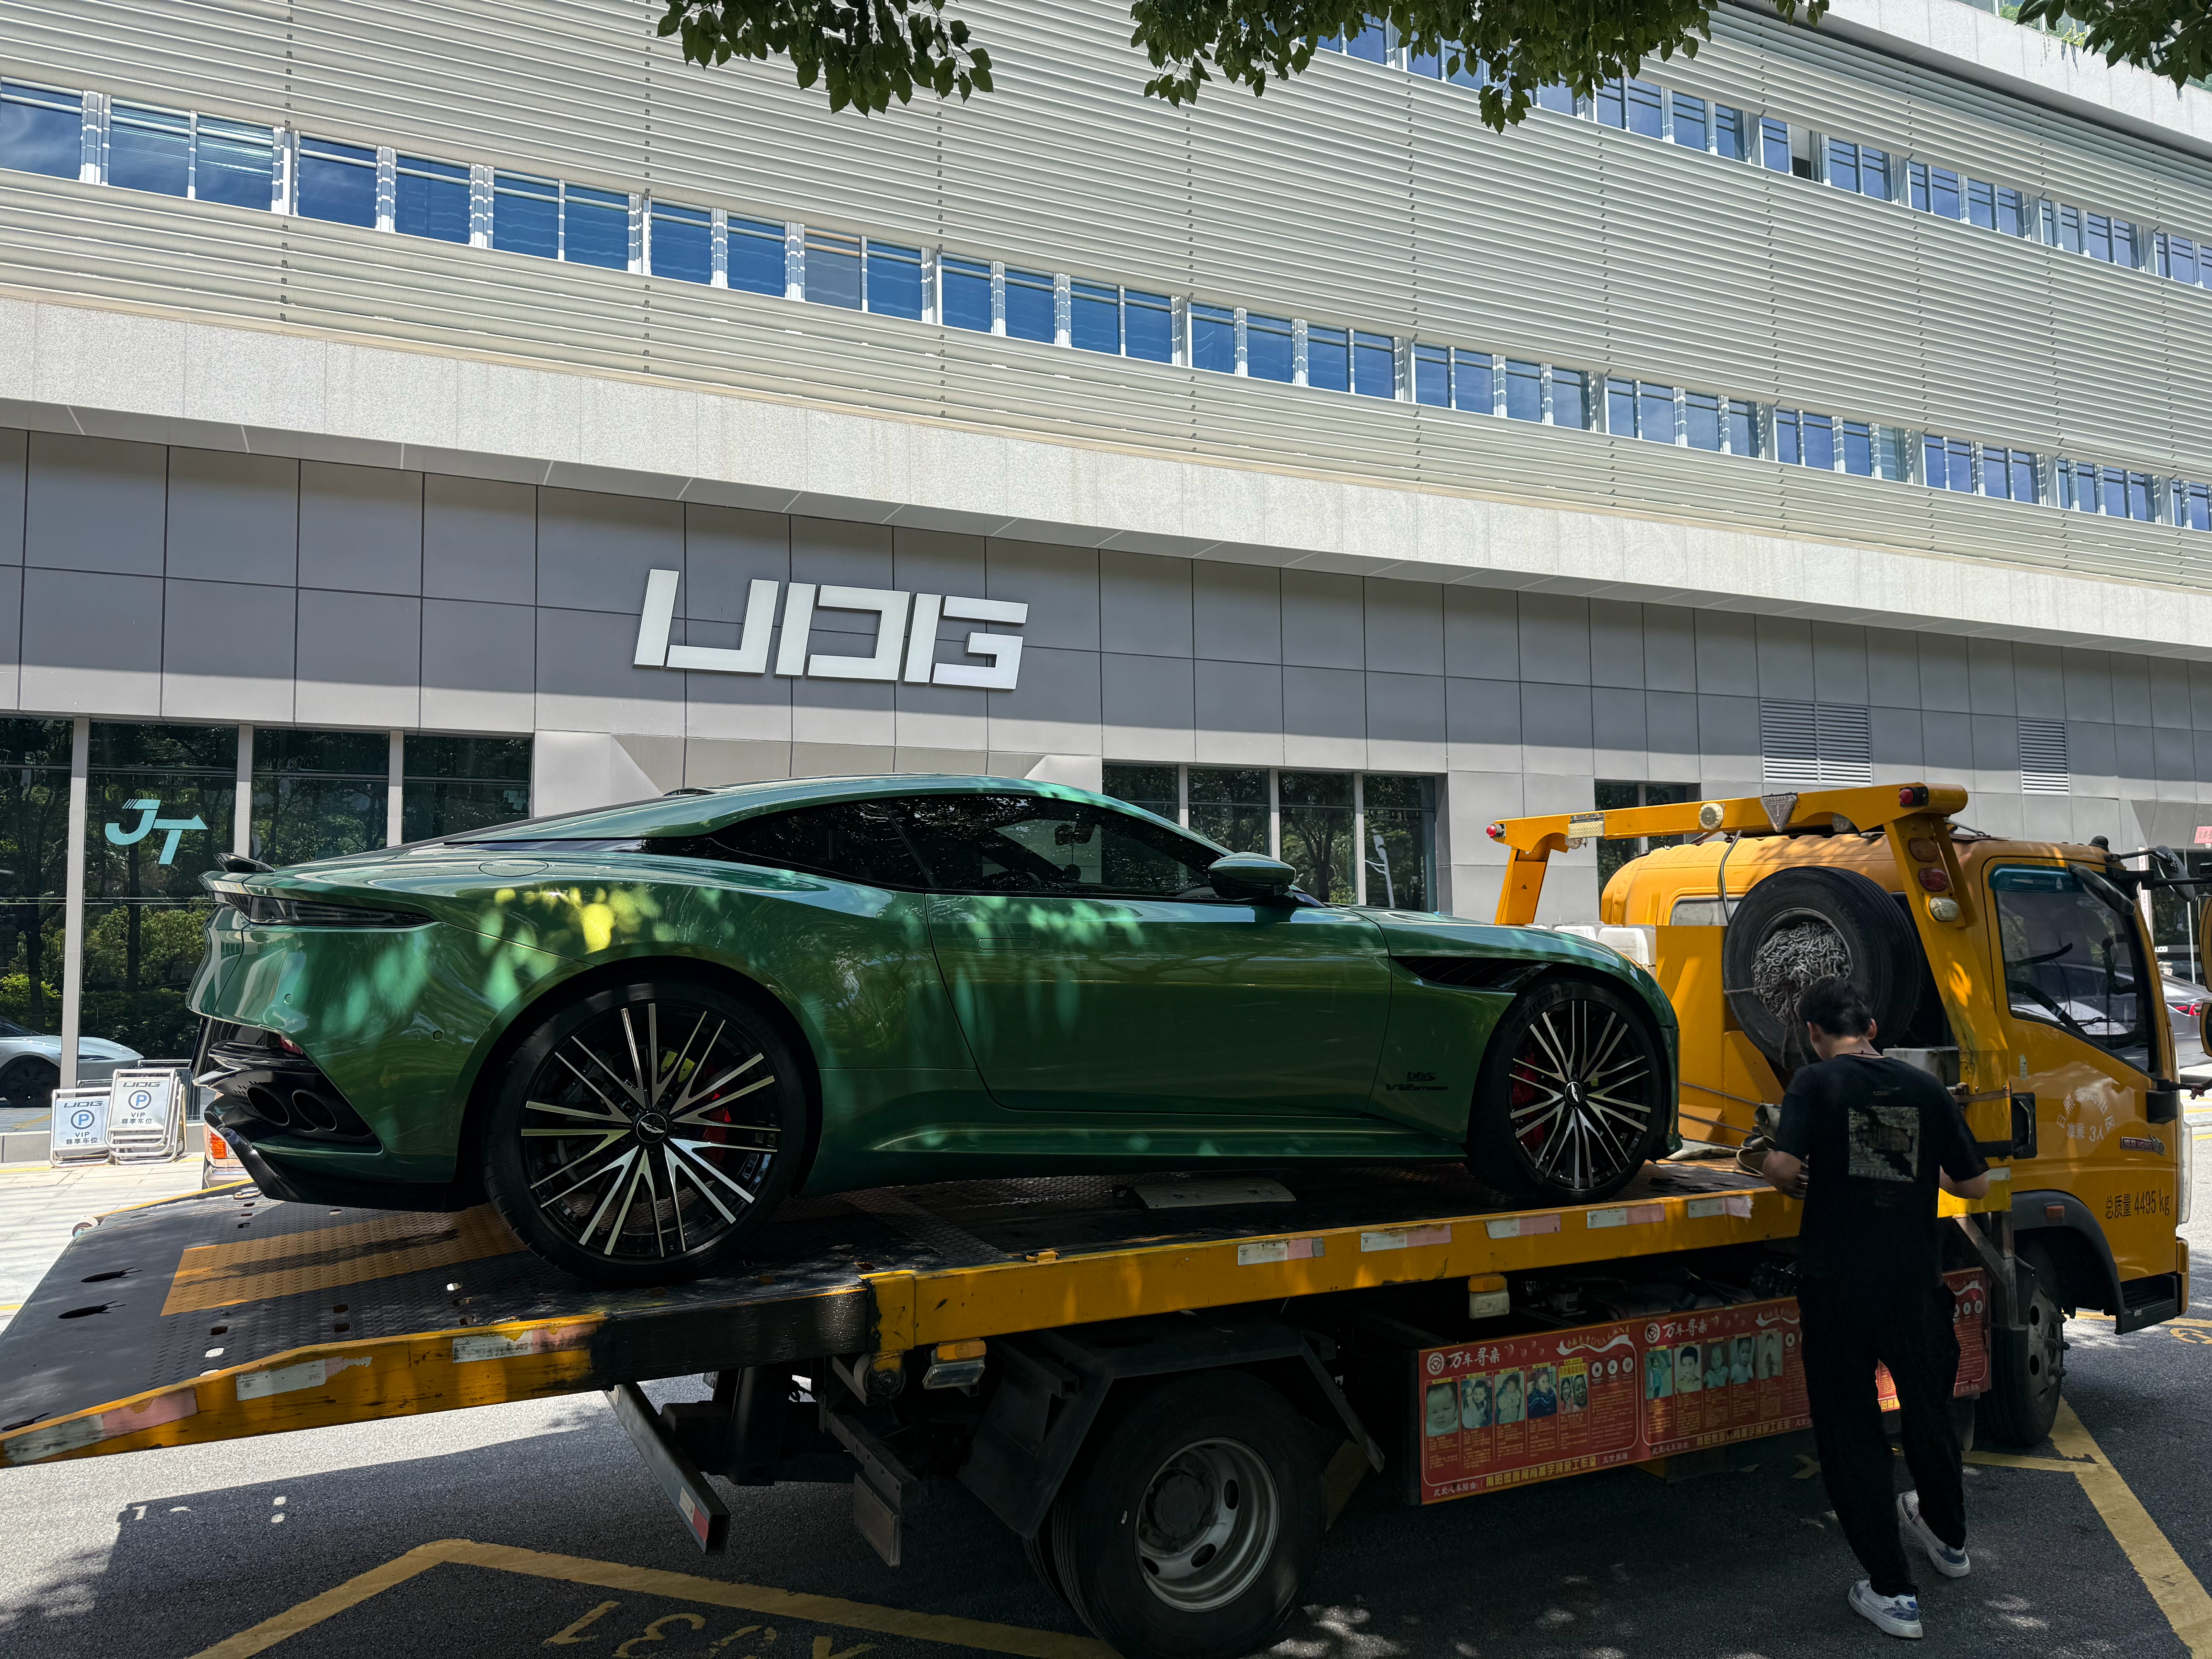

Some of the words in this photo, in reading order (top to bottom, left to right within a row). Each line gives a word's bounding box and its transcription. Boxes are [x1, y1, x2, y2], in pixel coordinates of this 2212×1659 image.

[136, 1094, 147, 1106] P
[78, 1114, 89, 1125] P
[2105, 1193, 2131, 1219] 总质量
[2134, 1190, 2156, 1215] 4495
[2159, 1189, 2170, 1216] kg
[1662, 1318, 1707, 1338] 万车寻亲
[1447, 1346, 1500, 1369] 万车寻亲
